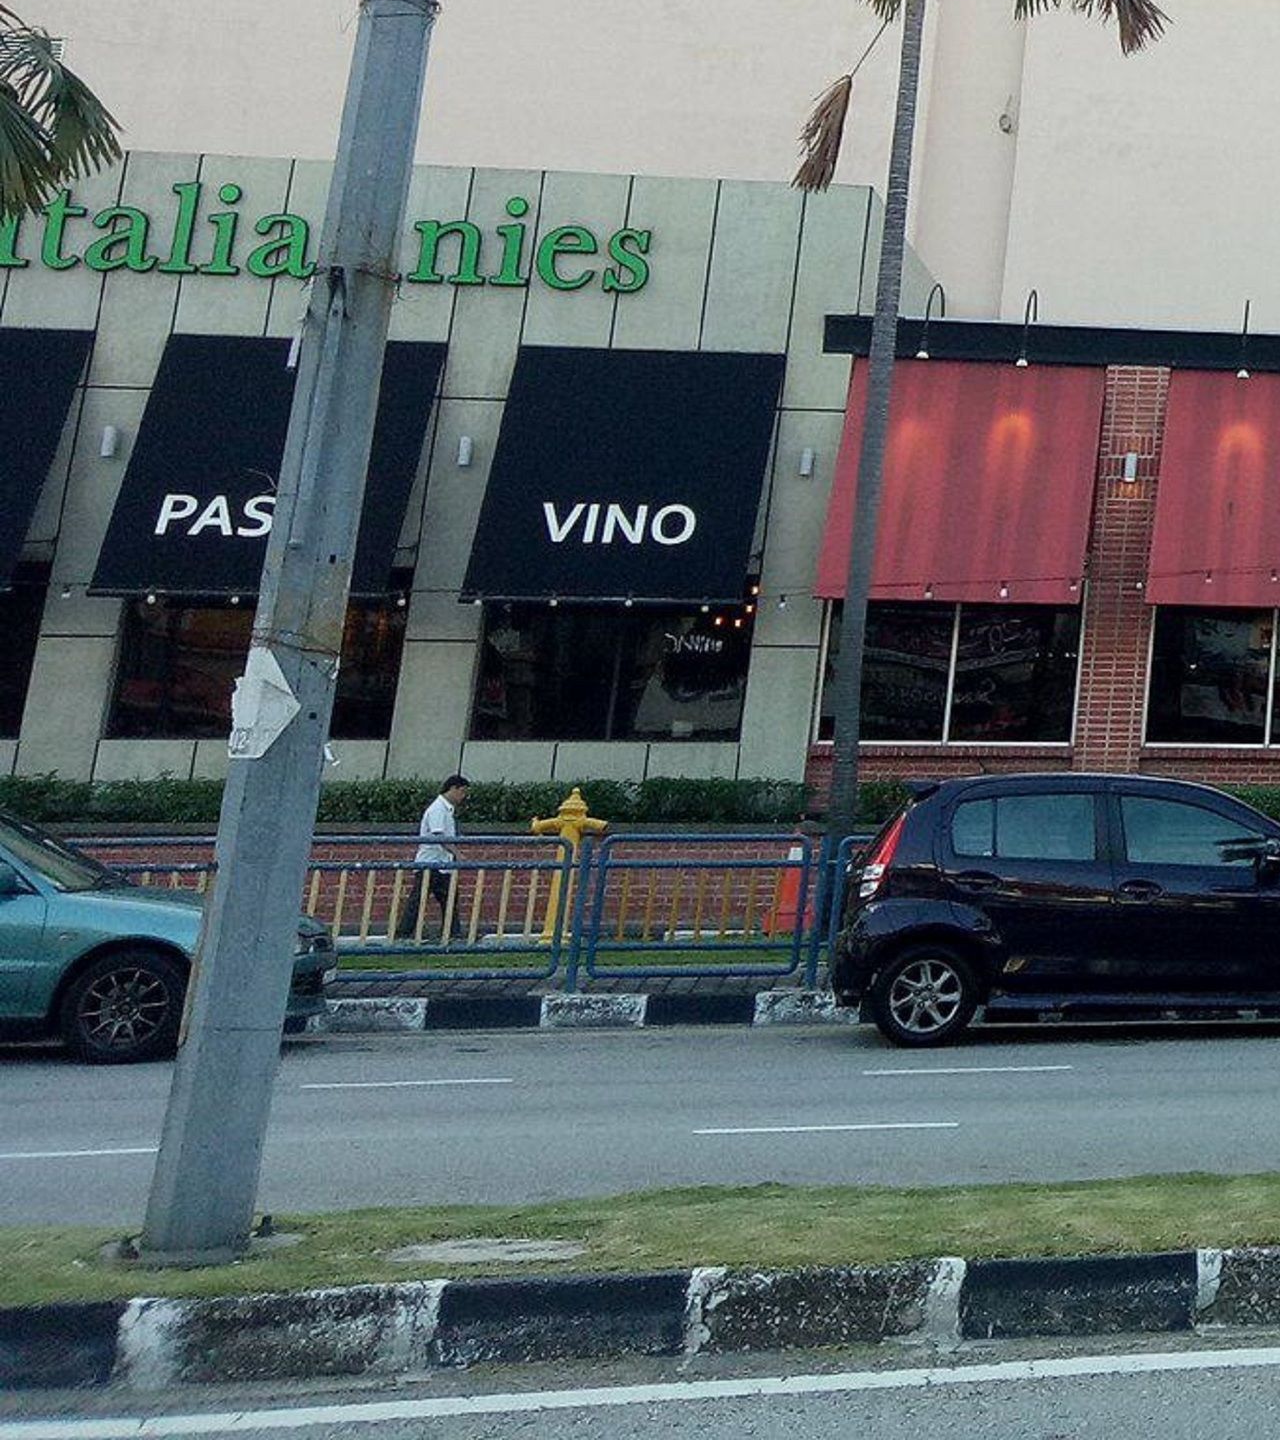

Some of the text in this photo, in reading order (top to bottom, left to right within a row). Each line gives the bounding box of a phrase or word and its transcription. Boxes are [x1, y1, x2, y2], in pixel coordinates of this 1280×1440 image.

[0, 180, 652, 293] talianies
[154, 494, 276, 537] PAS
[542, 501, 697, 545] VINO
